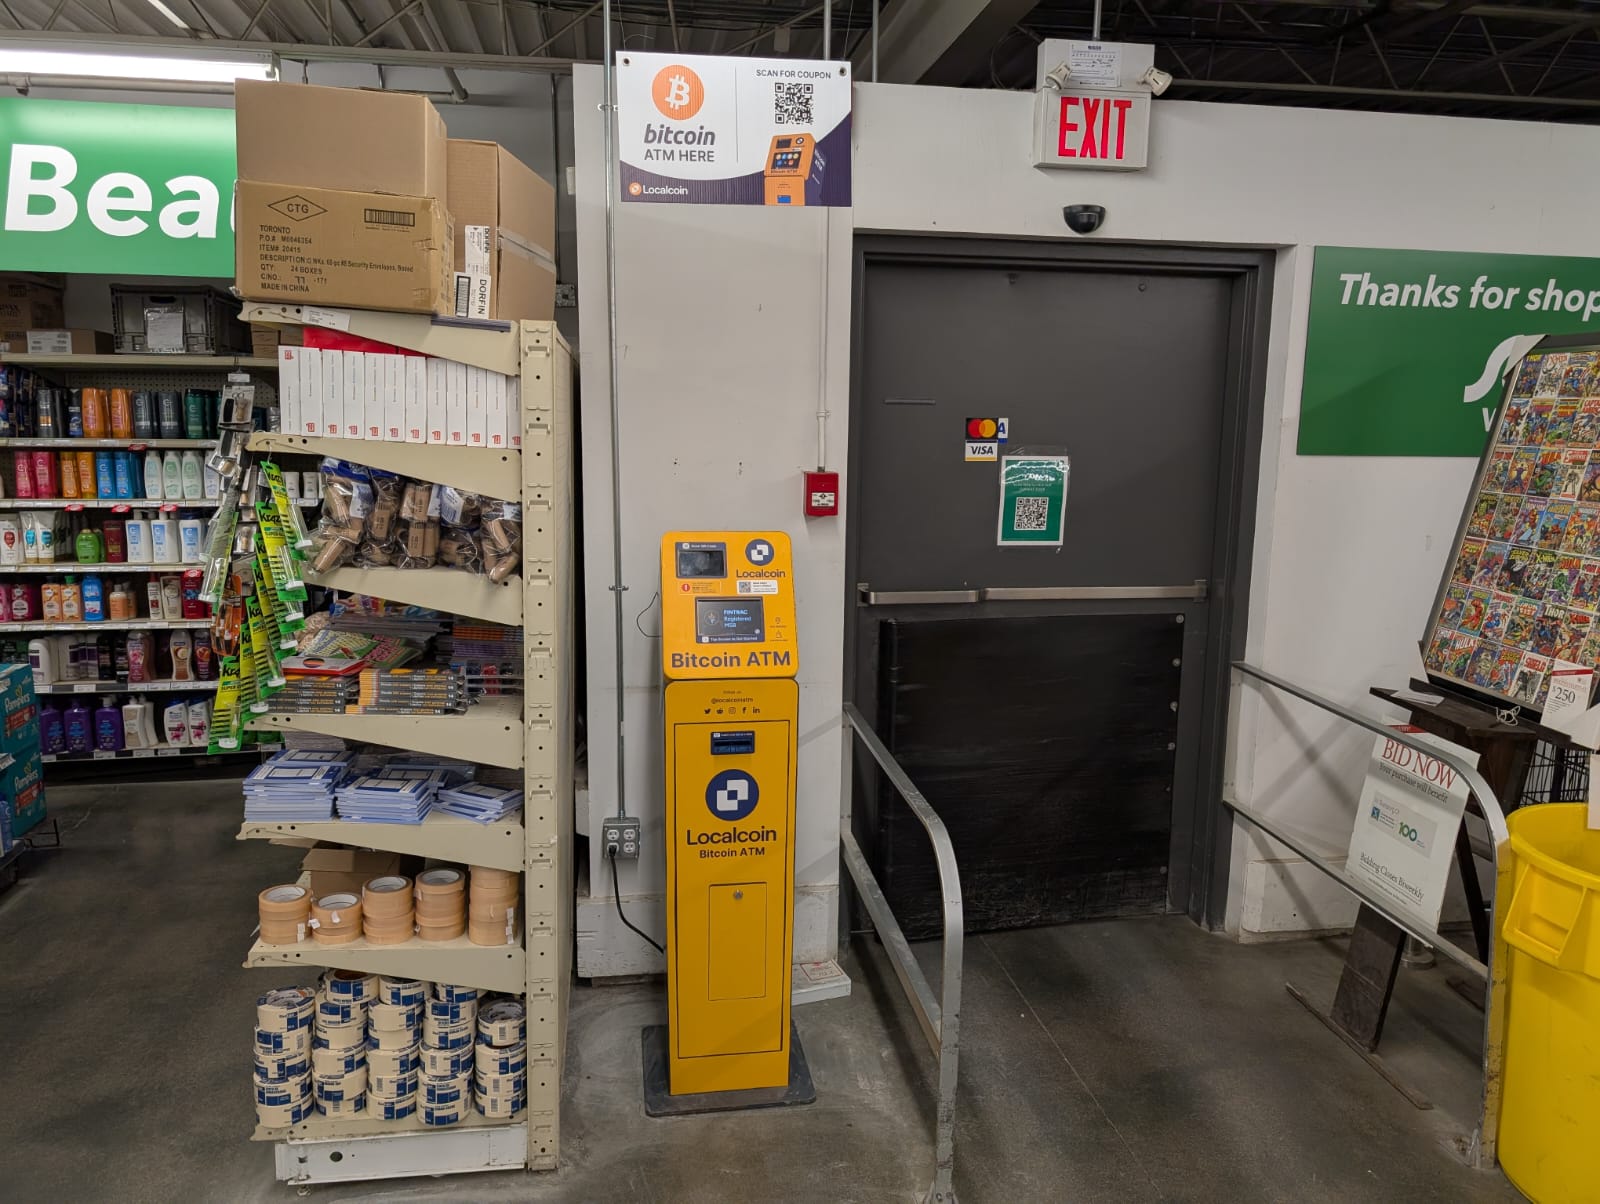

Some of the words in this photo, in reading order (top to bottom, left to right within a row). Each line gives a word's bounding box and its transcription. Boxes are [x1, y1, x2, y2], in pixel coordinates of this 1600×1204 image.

[755, 69, 778, 77] SCAN
[779, 70, 796, 78] FOR
[797, 71, 832, 79] COUPON
[644, 123, 716, 146] bitcoin
[1058, 96, 1132, 160] EXIT
[644, 148, 675, 162] ATM
[679, 149, 715, 162] HERE
[5, 143, 236, 239] Bea
[642, 181, 689, 195] Localcoin
[287, 203, 310, 214] CTG
[259, 225, 291, 234] TORONTO
[259, 244, 280, 252] ITEM#
[299, 267, 323, 275] BOXES
[261, 282, 280, 291] MADE
[288, 285, 310, 293] CHINA
[1339, 272, 1461, 309] Thanks
[1469, 275, 1520, 310] for
[478, 279, 487, 315] DORFIN
[970, 446, 994, 455] VISA
[736, 568, 786, 579] Localcoin
[671, 652, 740, 668] Bitcoin
[747, 650, 791, 666] ATM
[1382, 738, 1412, 767] BID
[1412, 752, 1457, 790] NOW
[686, 825, 777, 846] Localcoin
[1399, 821, 1418, 842] 100
[700, 849, 737, 859] Bitcoin
[740, 847, 765, 857] ATM
